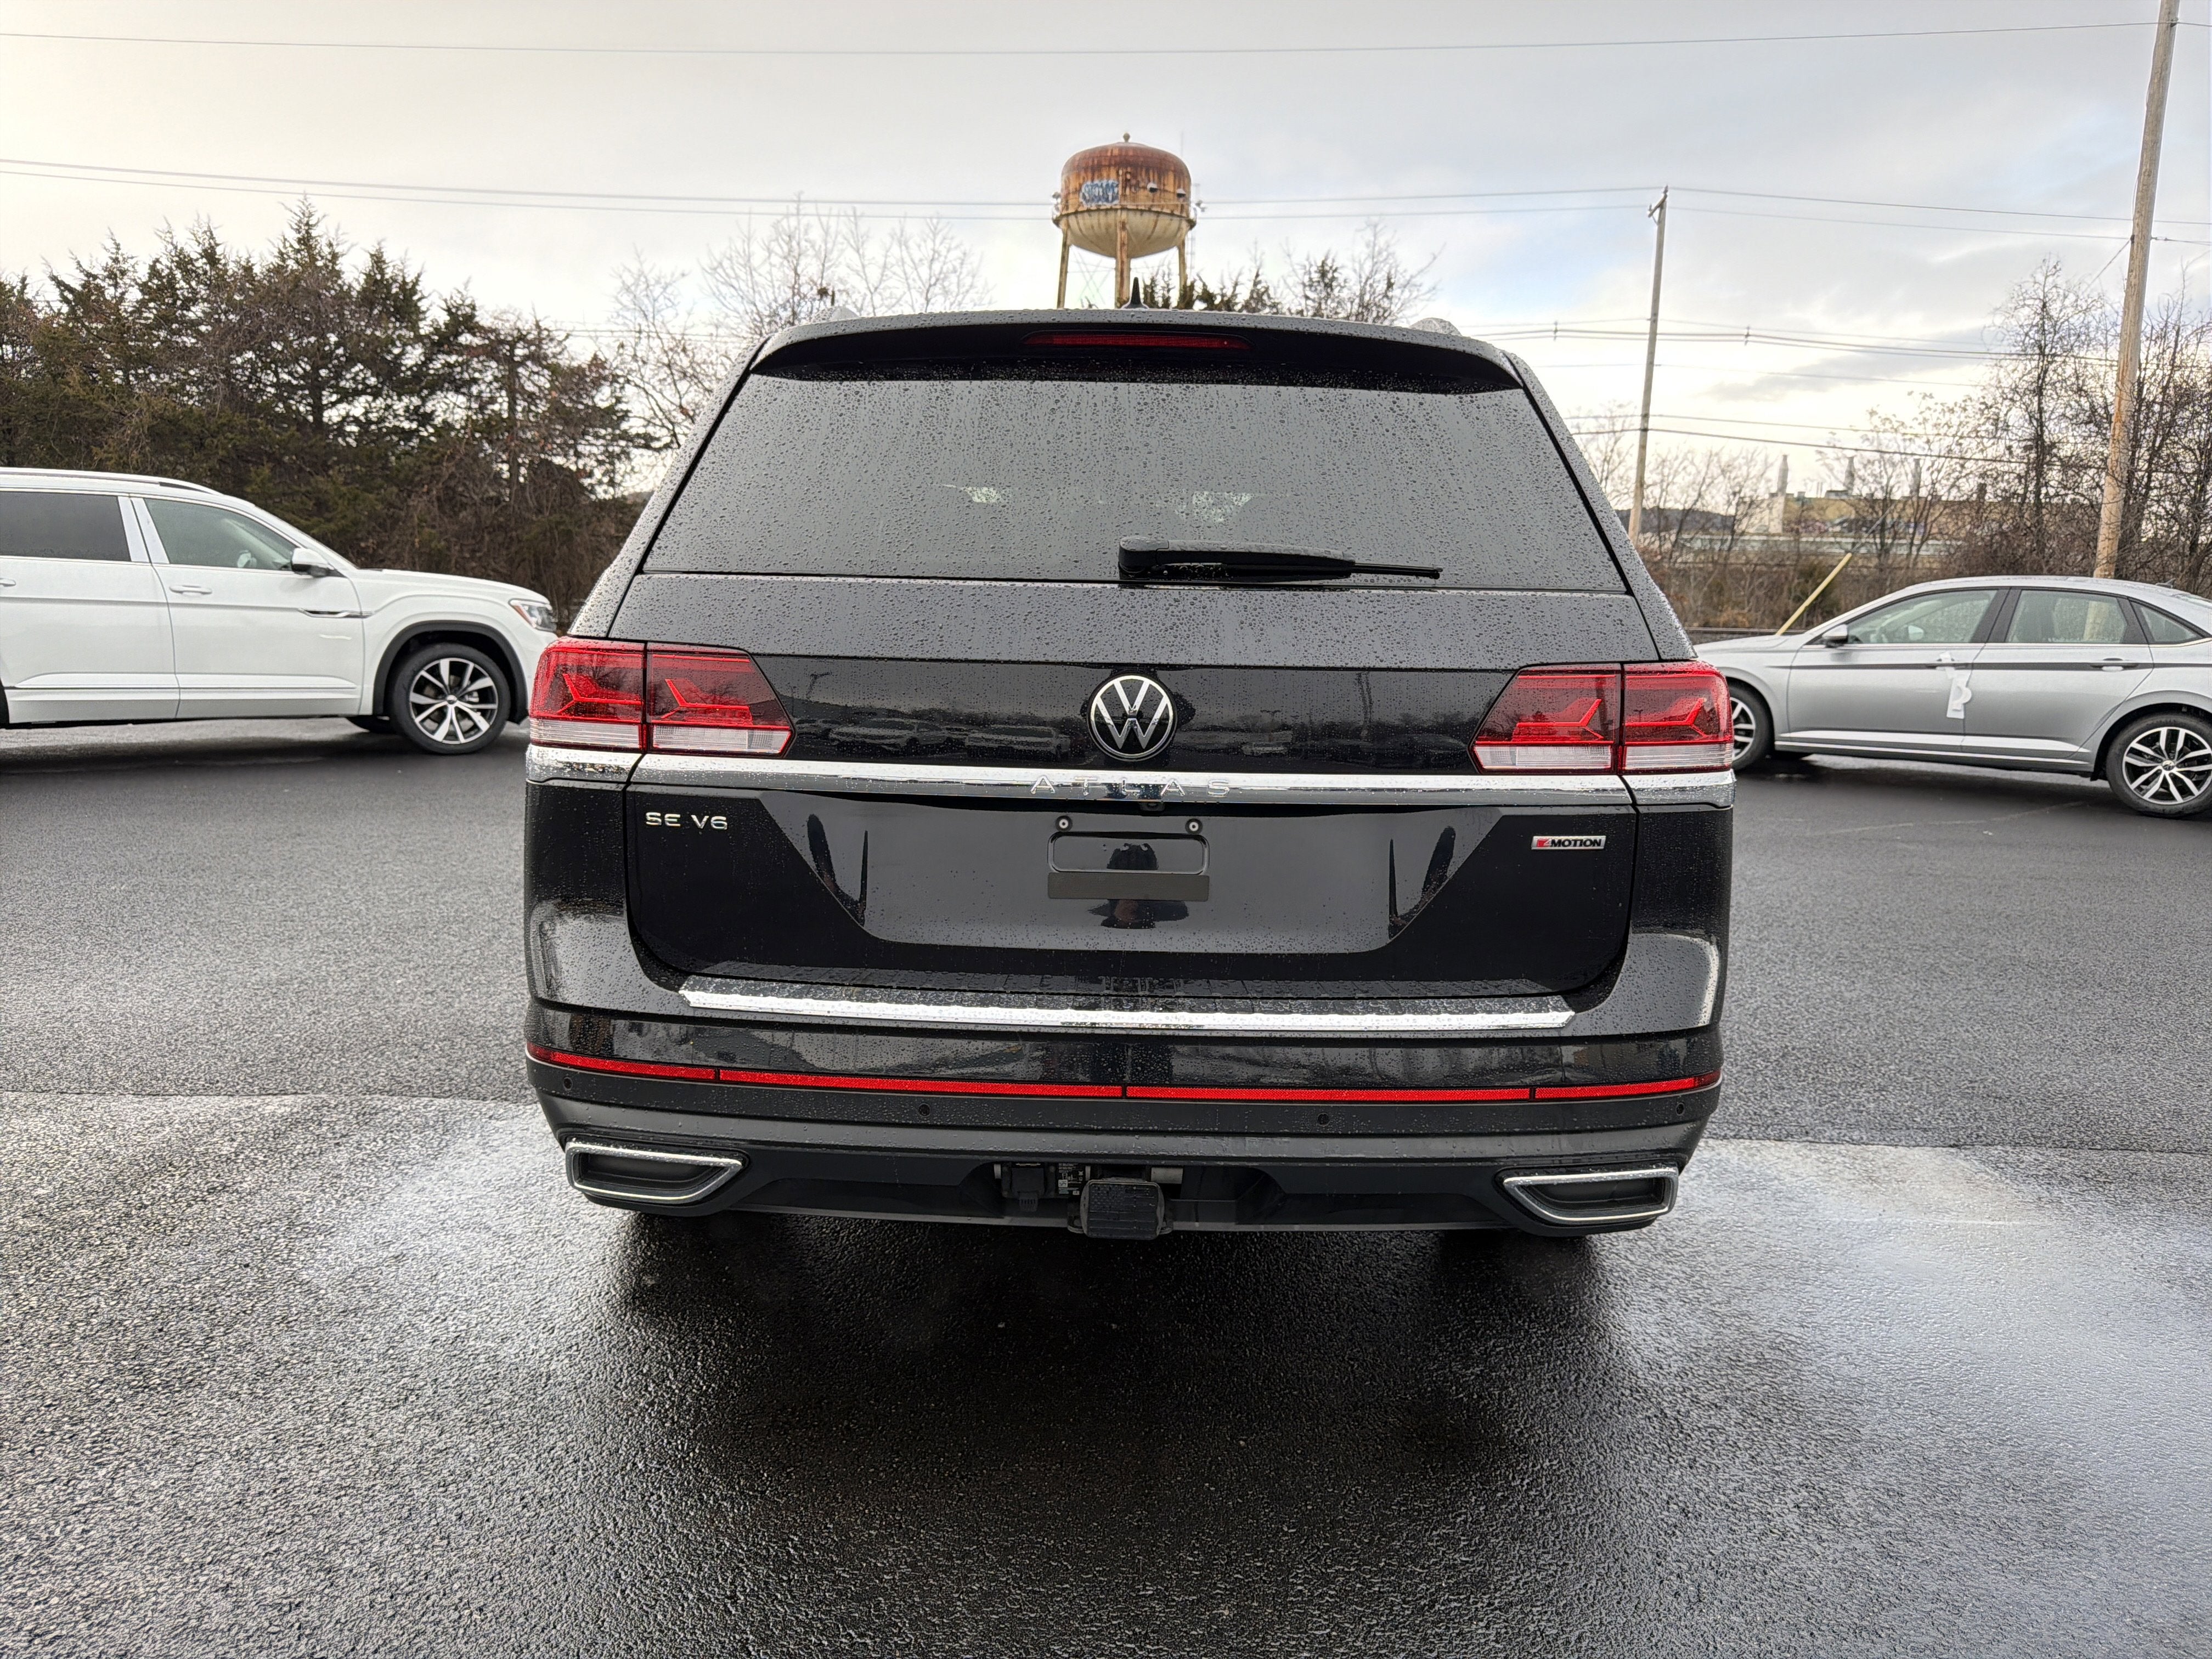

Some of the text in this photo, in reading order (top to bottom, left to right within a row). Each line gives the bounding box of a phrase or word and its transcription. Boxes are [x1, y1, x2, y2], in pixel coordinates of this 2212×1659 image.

[1030, 775, 1231, 798] ATLAS
[646, 812, 728, 830] SE V6
